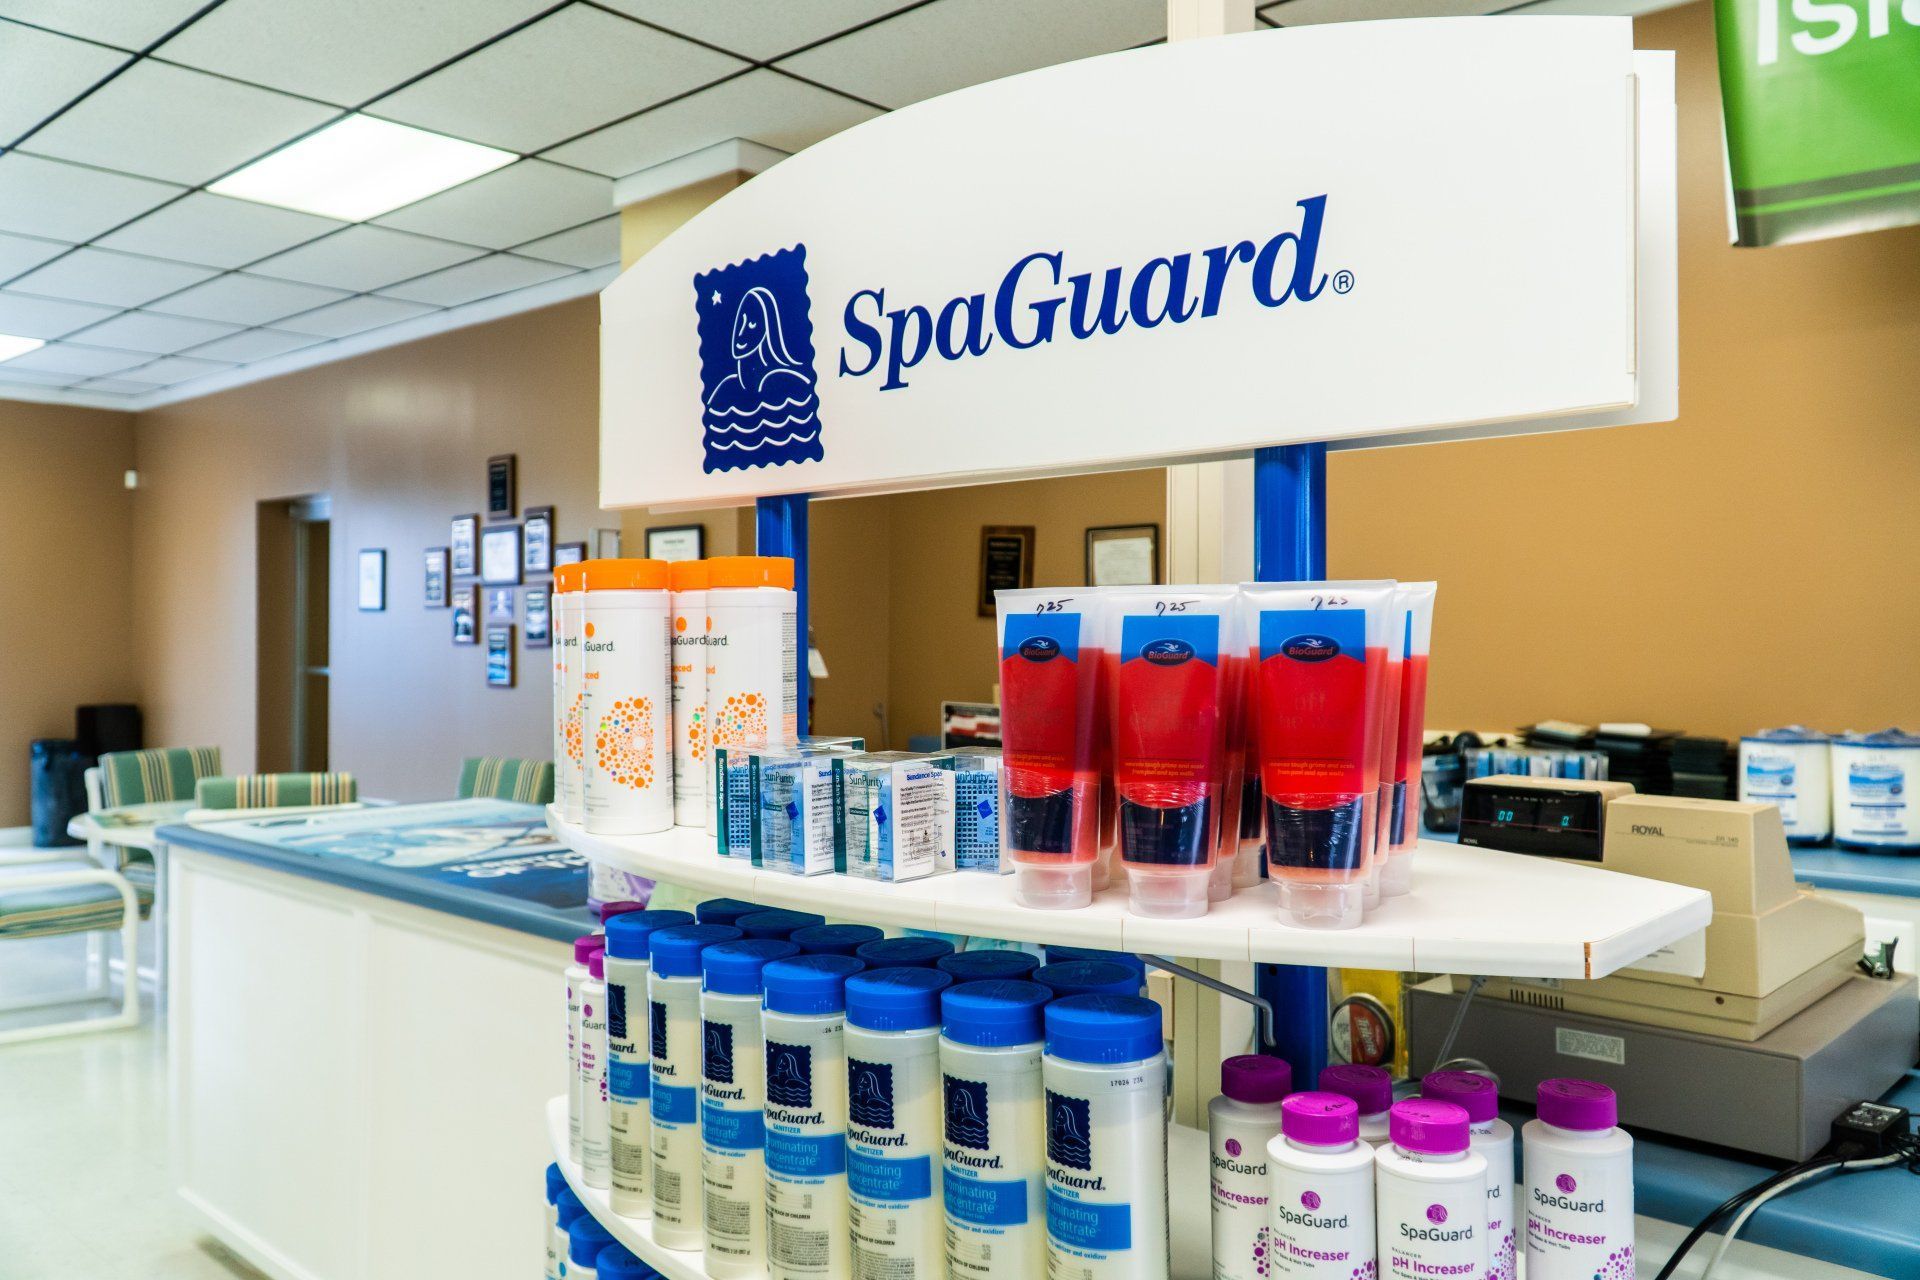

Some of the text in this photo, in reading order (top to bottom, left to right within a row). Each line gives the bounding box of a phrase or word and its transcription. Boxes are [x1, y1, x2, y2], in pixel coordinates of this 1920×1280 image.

[584, 641, 614, 652] Guard
[1148, 650, 1189, 660] BioGuard
[1289, 646, 1333, 656] BioGuard
[849, 774, 884, 789] SunPurity
[907, 771, 930, 781] Sundance
[1631, 825, 1664, 837] ROYAL
[1211, 1151, 1267, 1176] SpaGuard
[1218, 1186, 1269, 1206] Increaser
[1534, 1187, 1605, 1213] SpaGuard
[1279, 1205, 1348, 1228] SpaGuard
[1400, 1222, 1474, 1242] SpaGuard
[1528, 1218, 1606, 1245] pH Increaser
[1274, 1236, 1350, 1261] pH Increaser
[1392, 1255, 1475, 1275] pH Increaser
